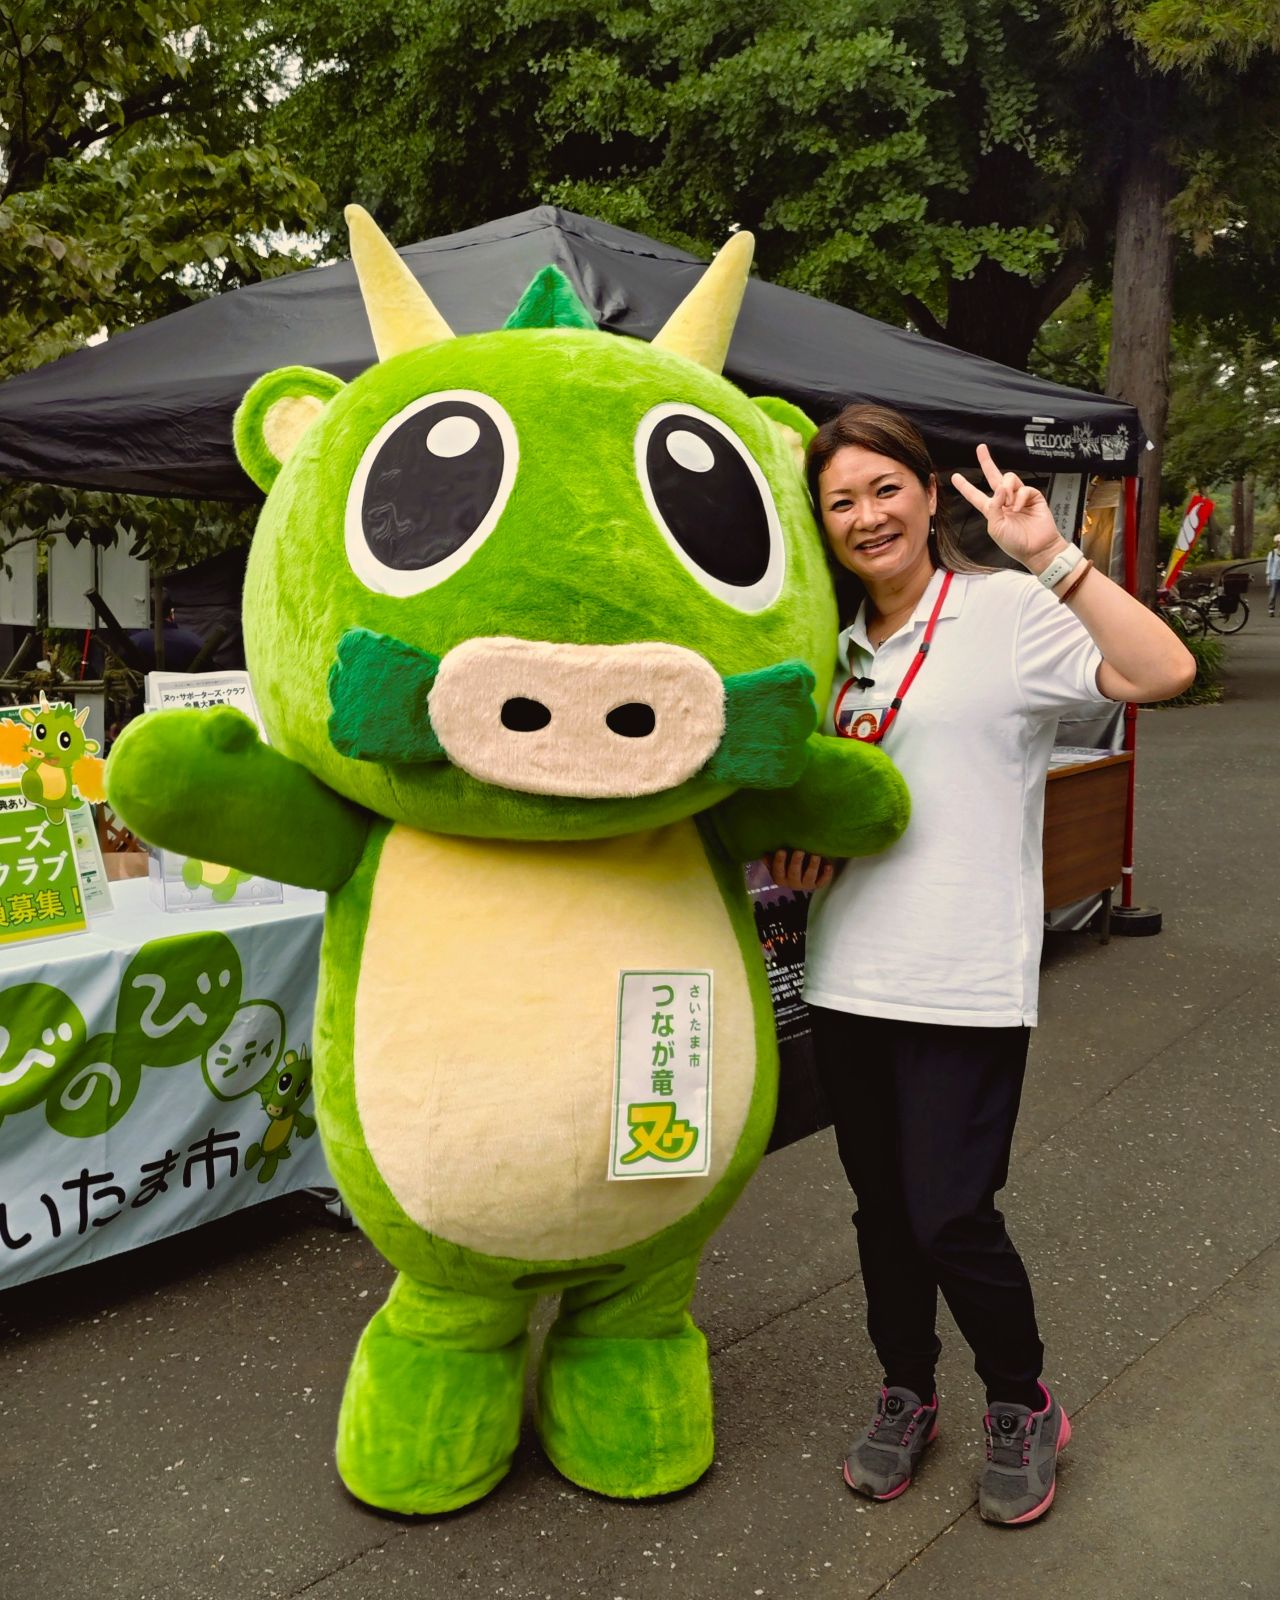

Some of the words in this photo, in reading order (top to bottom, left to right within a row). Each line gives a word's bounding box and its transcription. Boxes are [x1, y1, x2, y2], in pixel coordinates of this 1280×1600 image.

[688, 984, 701, 1068] さいたま市
